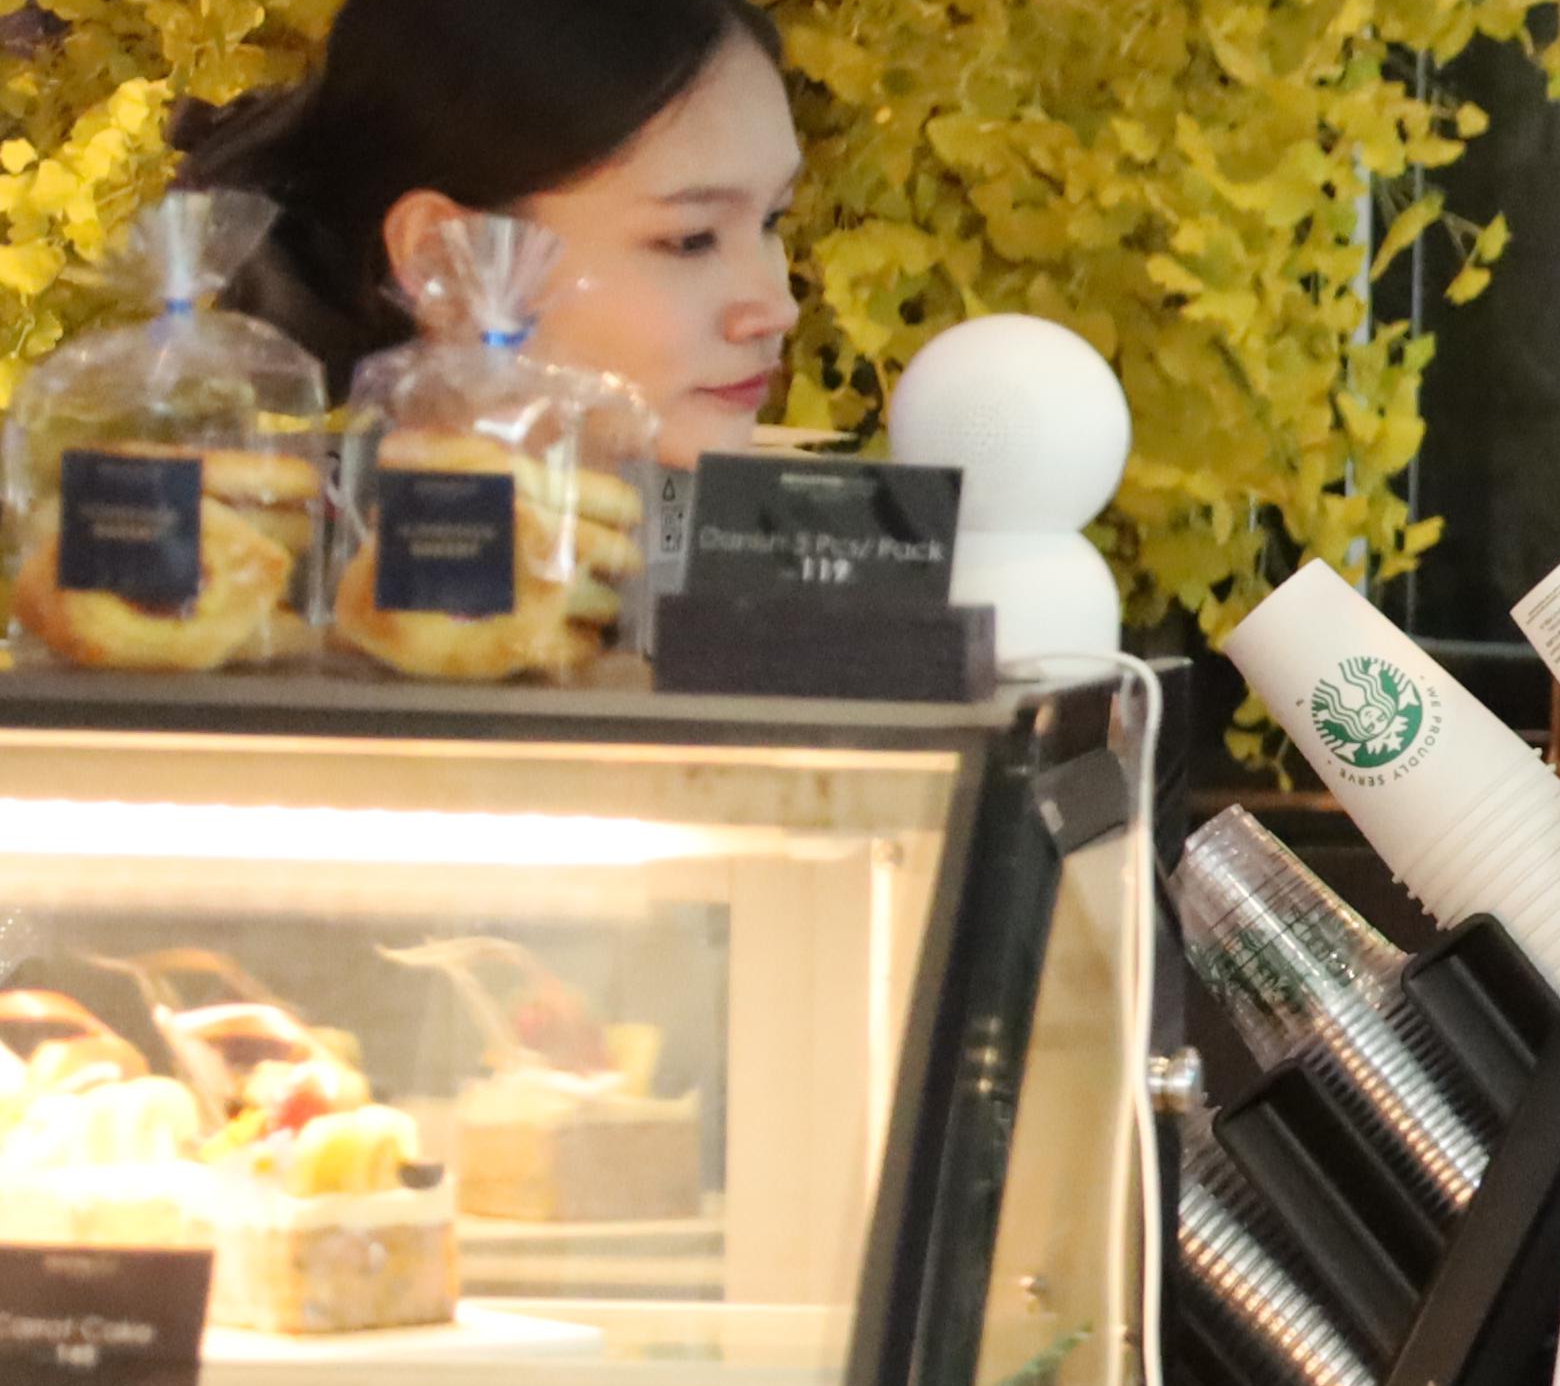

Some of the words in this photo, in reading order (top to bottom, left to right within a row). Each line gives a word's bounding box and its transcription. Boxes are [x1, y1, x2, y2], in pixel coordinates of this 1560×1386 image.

[1425, 685, 1442, 708] WE
[1393, 715, 1442, 780] PROUDLY
[1339, 767, 1386, 788] SERVE
